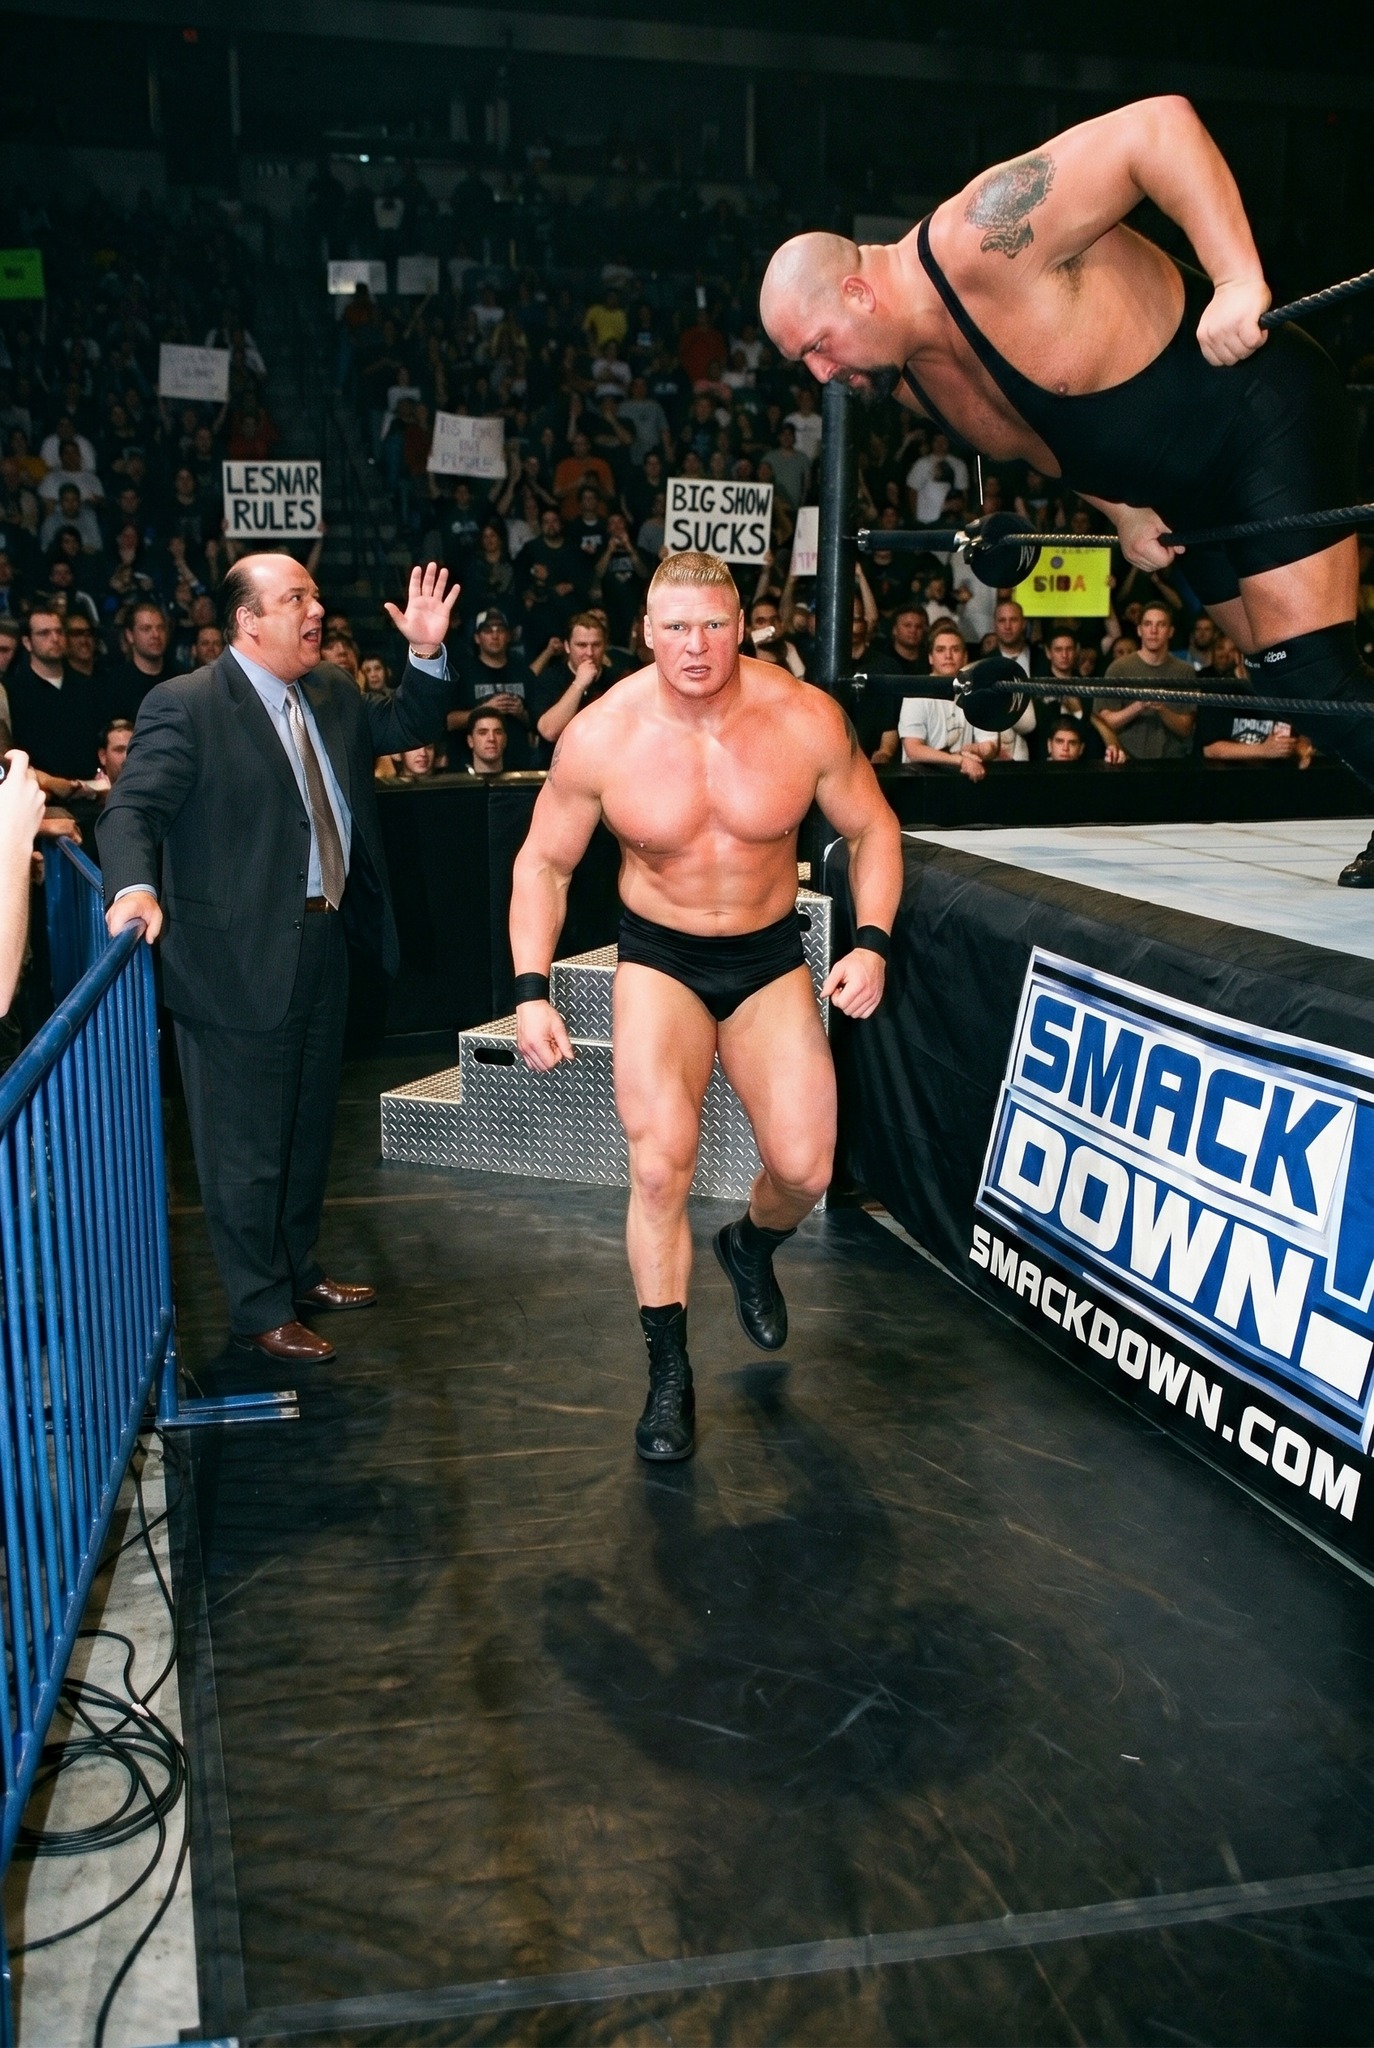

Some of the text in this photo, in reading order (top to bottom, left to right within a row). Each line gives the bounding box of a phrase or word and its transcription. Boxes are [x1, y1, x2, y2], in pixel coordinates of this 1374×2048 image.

[226, 466, 320, 495] LESNAR
[233, 499, 316, 530] RULES
[672, 483, 771, 517] BIG SHOW
[671, 519, 766, 556] SUCKS
[1021, 993, 1343, 1216] SMACK
[968, 1223, 1362, 1522] SMACKDOWN.COM
